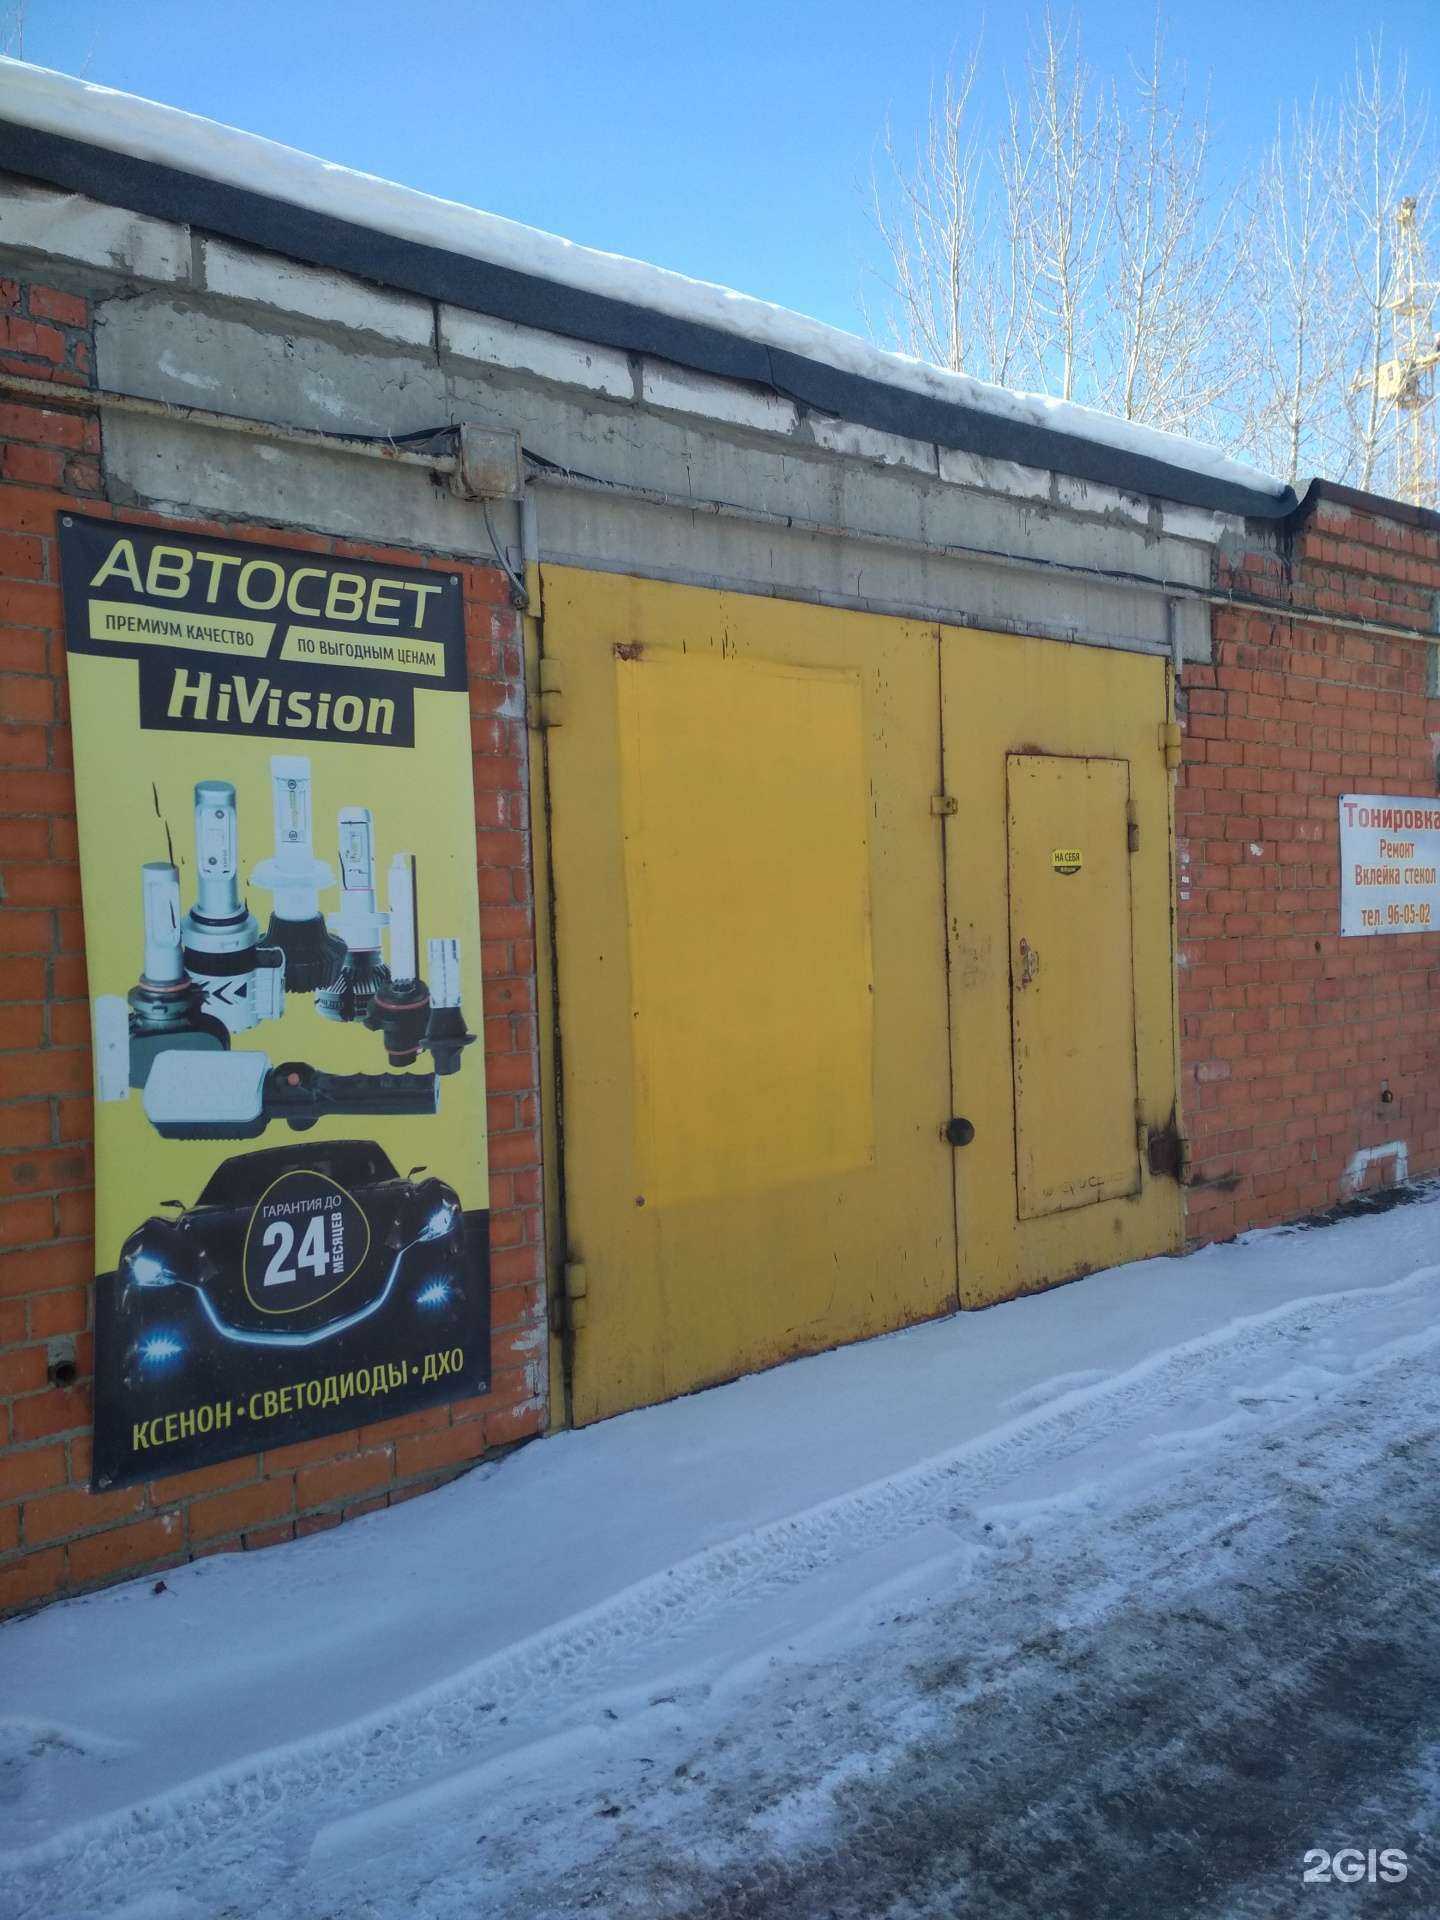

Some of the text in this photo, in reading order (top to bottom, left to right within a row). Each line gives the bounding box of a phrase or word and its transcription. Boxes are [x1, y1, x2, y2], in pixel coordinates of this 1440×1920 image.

[89, 538, 442, 628] АВТОСВЕТ
[105, 614, 255, 647] ПРЕМИУМ КАЧЕСТВО
[297, 638, 437, 667] ПО ВЫГОДНЫМ ЦЕНАМ
[166, 667, 396, 736] HiVision
[1343, 803, 1440, 833] Тонировка
[1054, 851, 1080, 862] НА СЕБЯ
[1379, 838, 1415, 858] Ремонт
[1354, 864, 1437, 886] Вклейка стекол
[1361, 903, 1431, 926] тел. 96-05-02
[262, 1194, 342, 1217] ГАРАНТИЯ ДО
[262, 1215, 330, 1287] 24
[332, 1212, 344, 1274] МЕСЯЦЕВ
[132, 1347, 464, 1451] КСЕНОН СВЕТОДИОДЫ ДХО
